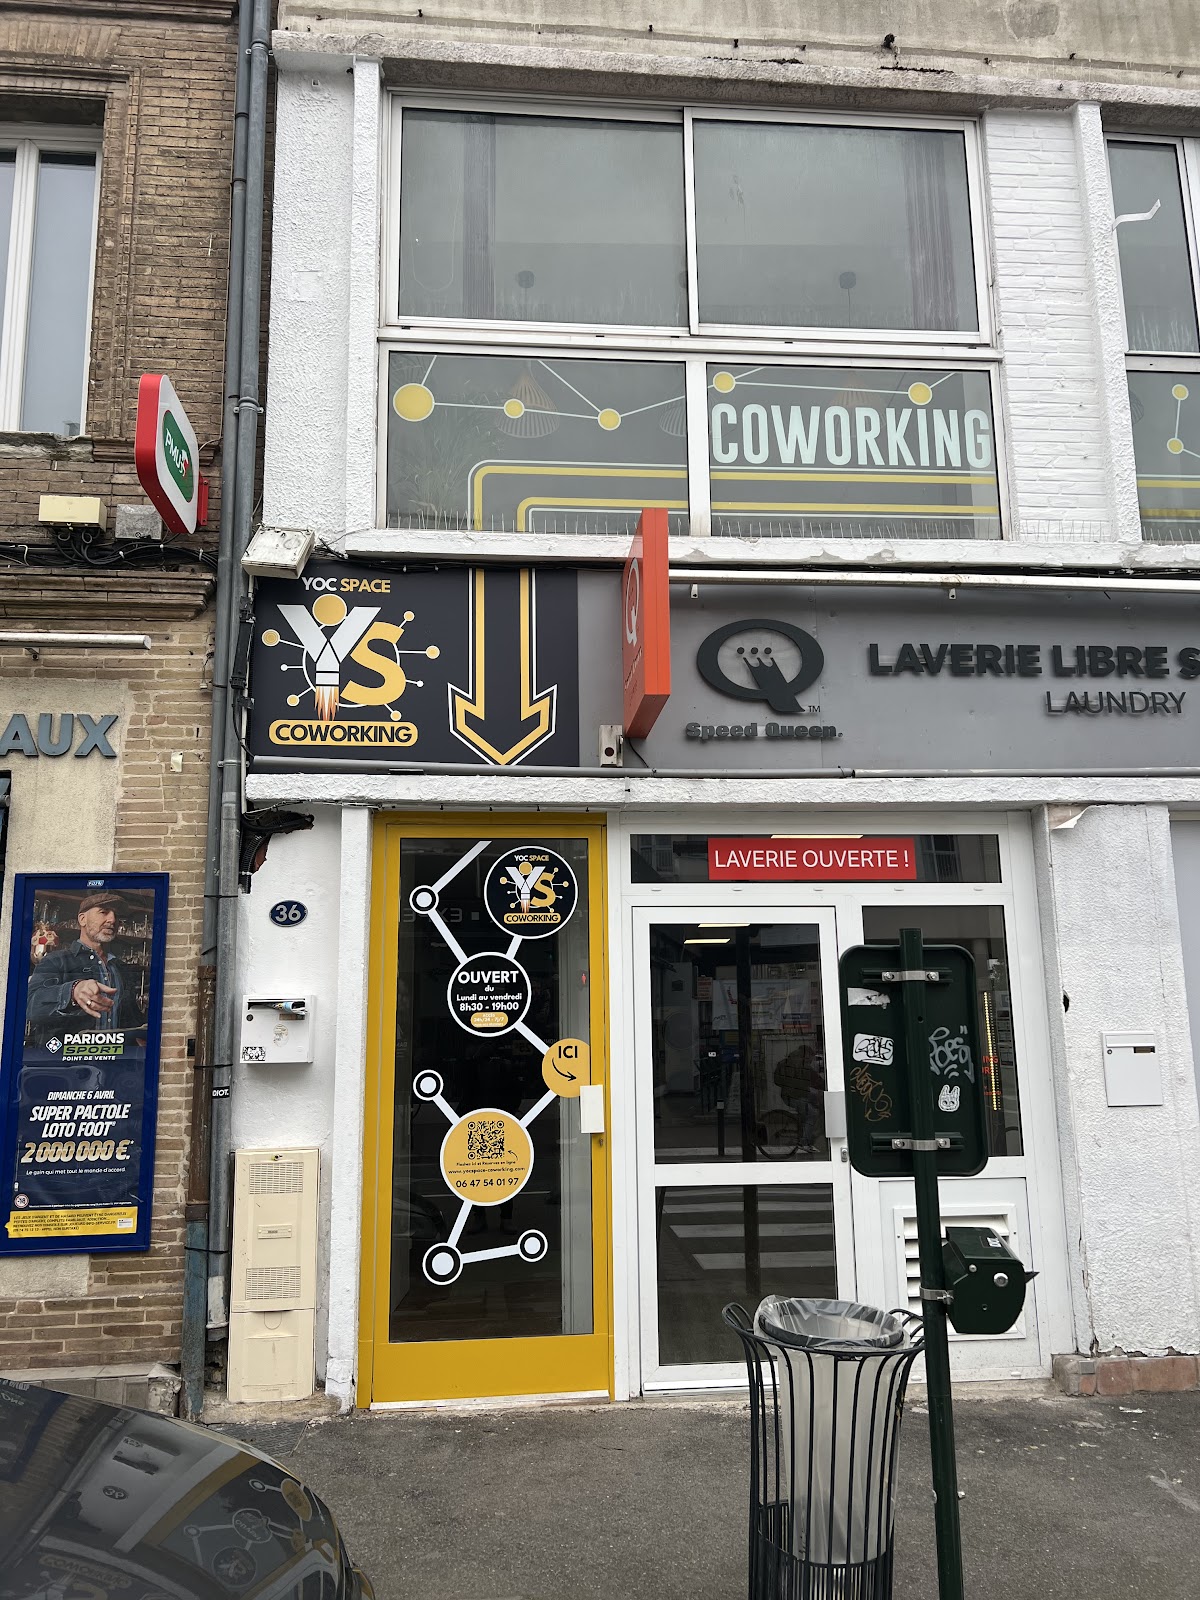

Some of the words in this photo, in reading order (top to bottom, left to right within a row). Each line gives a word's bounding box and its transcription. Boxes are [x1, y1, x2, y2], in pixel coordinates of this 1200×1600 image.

[711, 403, 992, 469] COWORKING
[165, 428, 183, 469] PMU
[301, 577, 338, 592] YOC
[340, 578, 391, 594] SPACE
[869, 643, 1043, 676] LAVERIE
[1052, 644, 1170, 678] LIBRE
[1046, 691, 1187, 715] LAUNDRY
[0, 713, 118, 758] AUX
[275, 723, 413, 744] COWORKING
[686, 722, 758, 740] Speed
[514, 854, 529, 862] YOC
[529, 854, 550, 862] SPACE
[714, 850, 798, 868] LAVERIE
[802, 850, 899, 868] OUVERTE
[903, 849, 909, 868] !
[275, 904, 302, 922] 36
[506, 914, 559, 923] COWORKING
[458, 971, 519, 984] OUVERT
[460, 1003, 483, 1011] 8h30
[492, 1002, 519, 1011] 19h00
[63, 1033, 124, 1044] PARIONS
[66, 1046, 121, 1054] SPORT
[558, 1046, 578, 1059] ICI
[47, 1091, 86, 1100] DIMANCHE
[87, 1091, 93, 1099] 6
[94, 1090, 115, 1099] AVRIL
[30, 1106, 72, 1121] SUPER
[74, 1104, 131, 1120] PACTOLE
[42, 1122, 76, 1138] LOTO
[456, 1180, 467, 1188] 06
[470, 1179, 480, 1187] 47
[484, 1178, 494, 1186] 54
[496, 1178, 506, 1186] 01
[508, 1178, 519, 1186] 97
